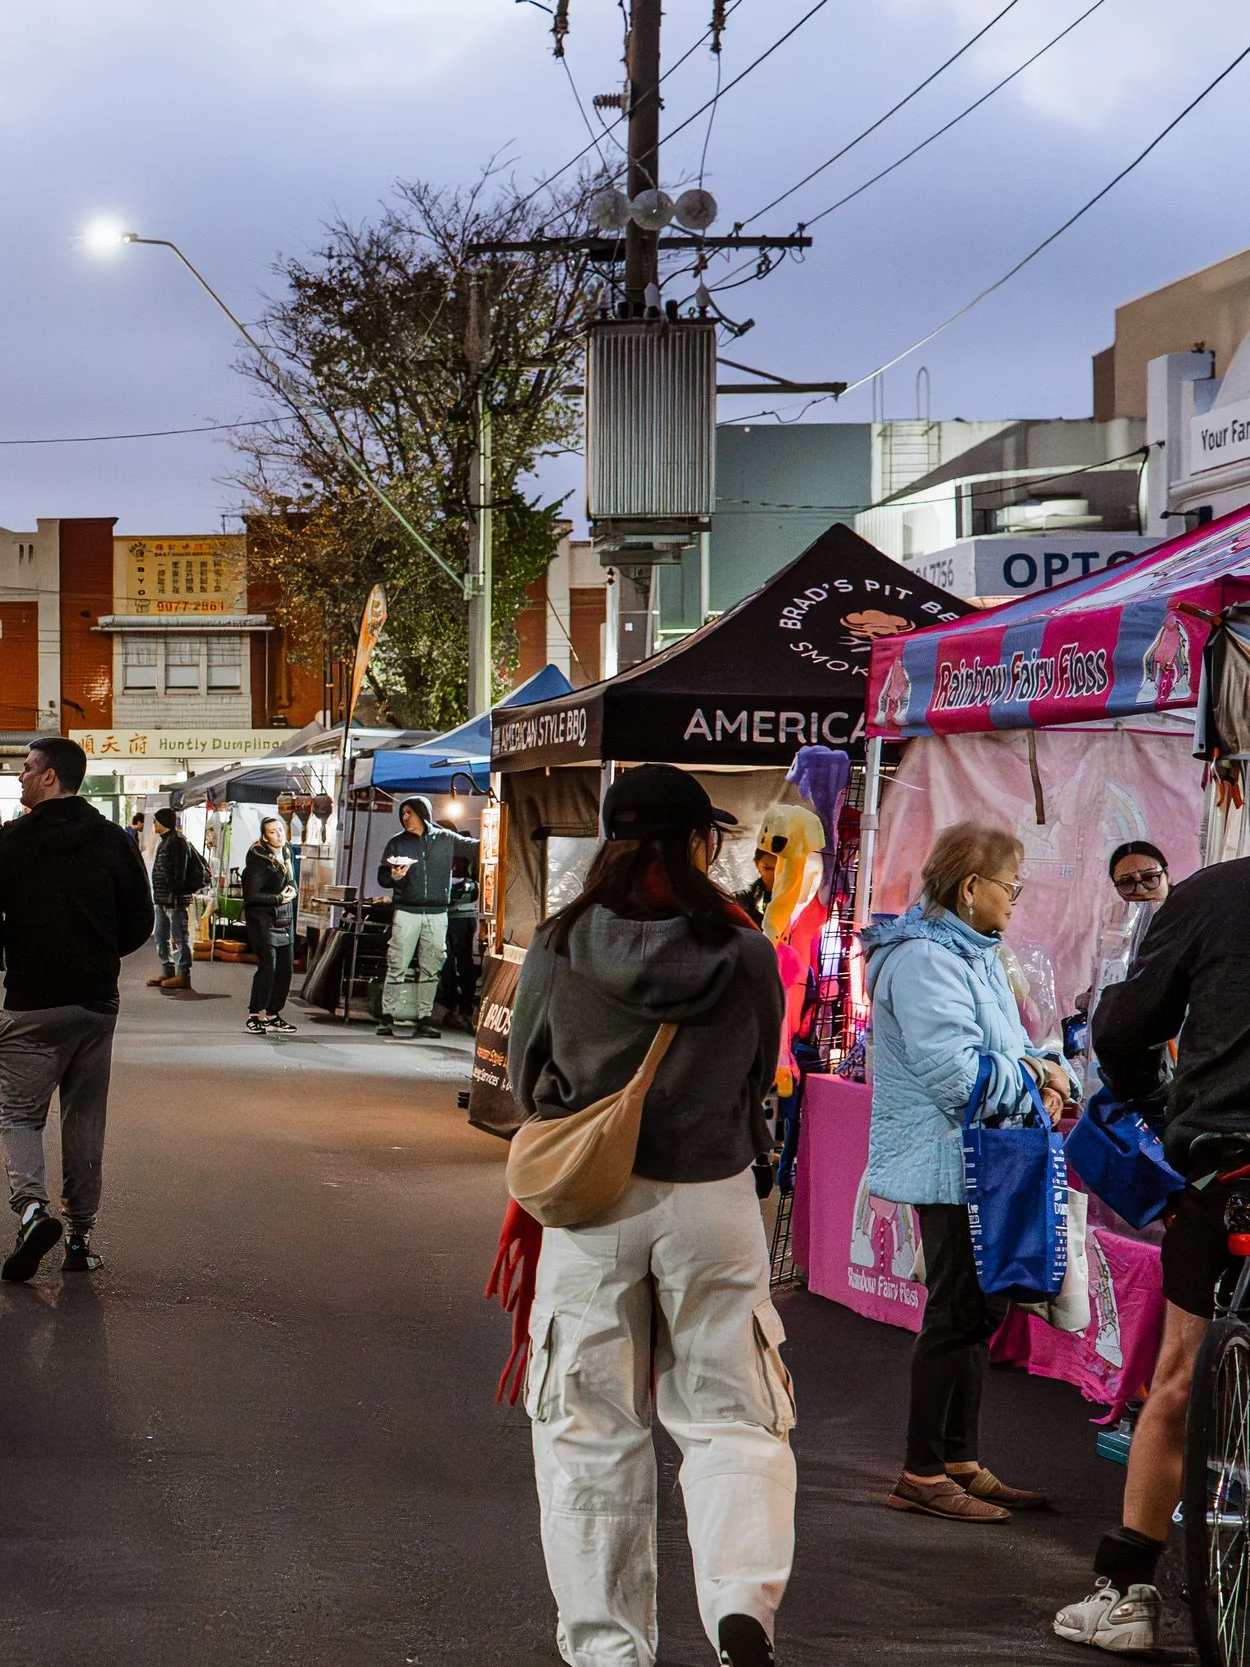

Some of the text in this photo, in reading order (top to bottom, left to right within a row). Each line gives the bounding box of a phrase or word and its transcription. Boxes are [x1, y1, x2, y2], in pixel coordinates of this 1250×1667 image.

[1201, 428, 1228, 452] Your
[779, 579, 854, 630] BRAD'S
[864, 579, 913, 600] PIT
[932, 642, 1109, 711] Rainbow Fairy Floss
[158, 737, 208, 753] Huntly
[501, 707, 587, 752] AMERICAN STYLE BBQ
[847, 1266, 877, 1294] Rainbow
[877, 1275, 899, 1301] Fairy
